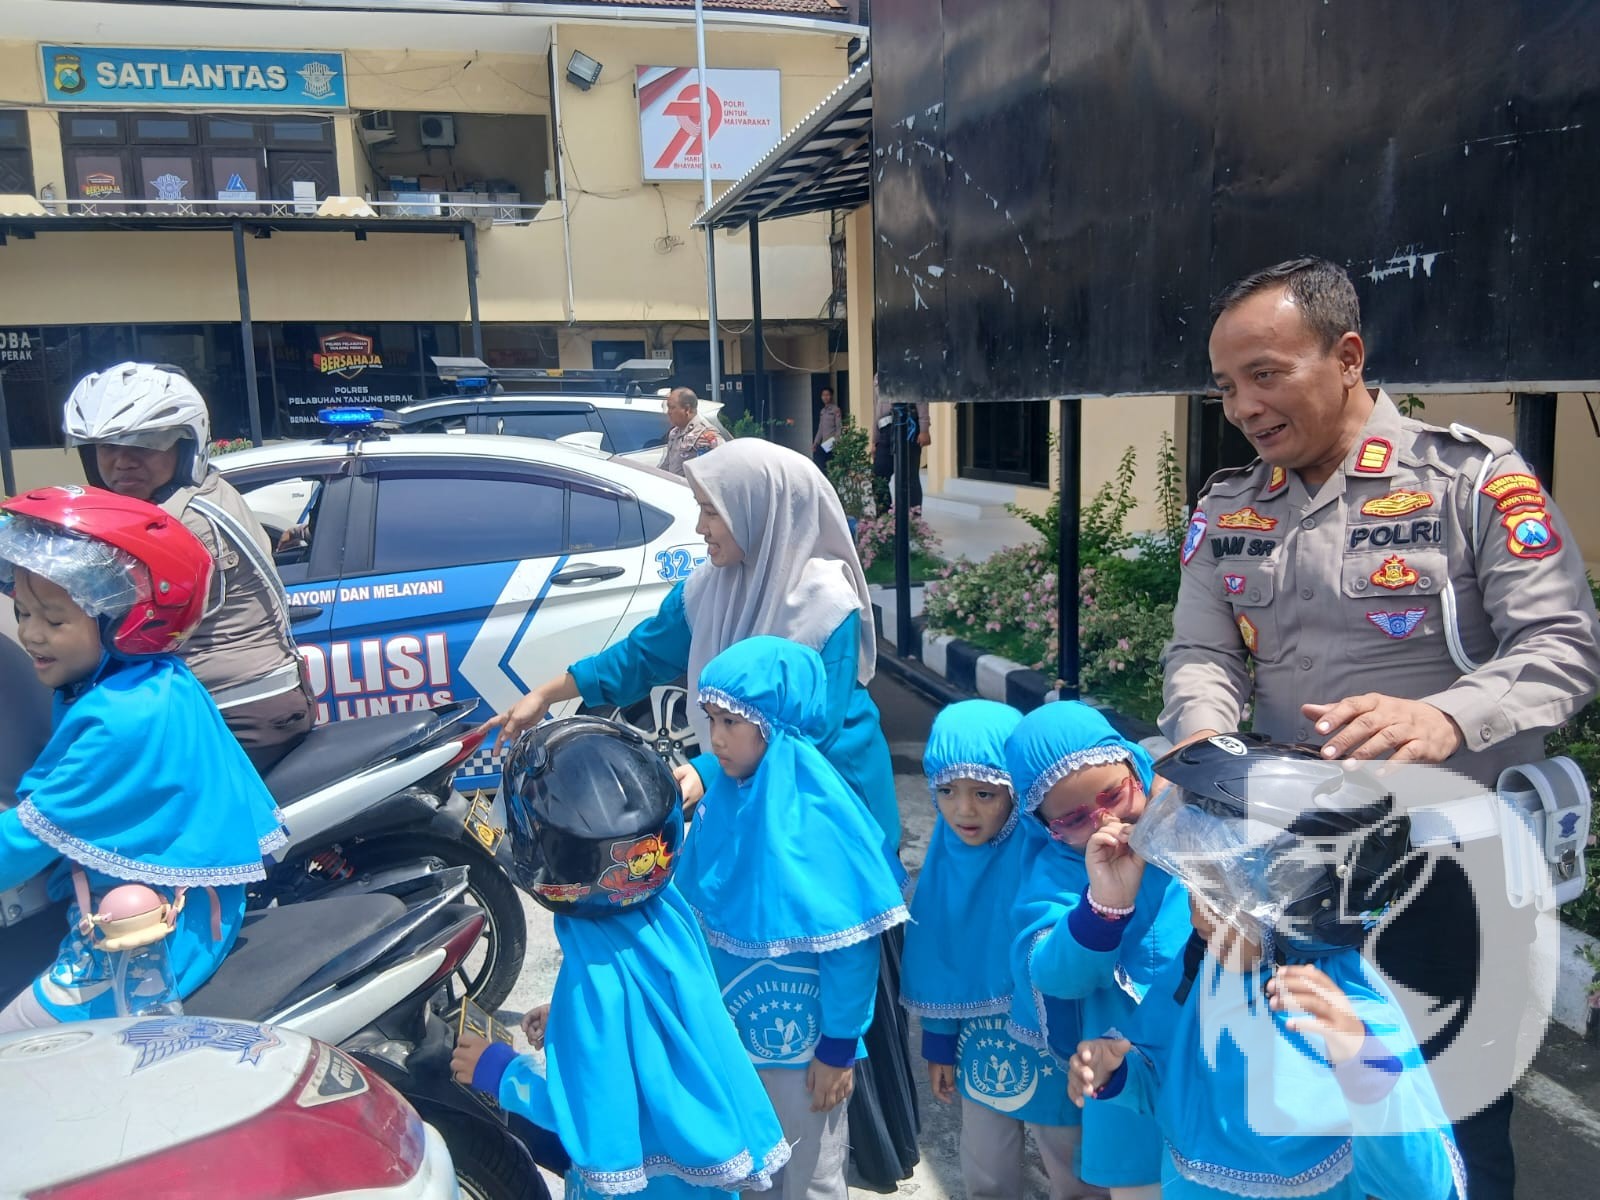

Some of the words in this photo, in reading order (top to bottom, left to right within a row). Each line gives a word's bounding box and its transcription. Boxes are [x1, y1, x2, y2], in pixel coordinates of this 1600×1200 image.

[96, 61, 287, 91] SATLANTAS
[1, 350, 33, 361] PERAK
[320, 354, 382, 373] BERSAHAJA
[288, 396, 342, 405] PELABUHAN
[383, 394, 415, 402] PERAK
[334, 386, 369, 394] POLRES
[1350, 520, 1442, 548] POLRI
[340, 587, 370, 602] DAN
[373, 580, 443, 599] MELAYANI
